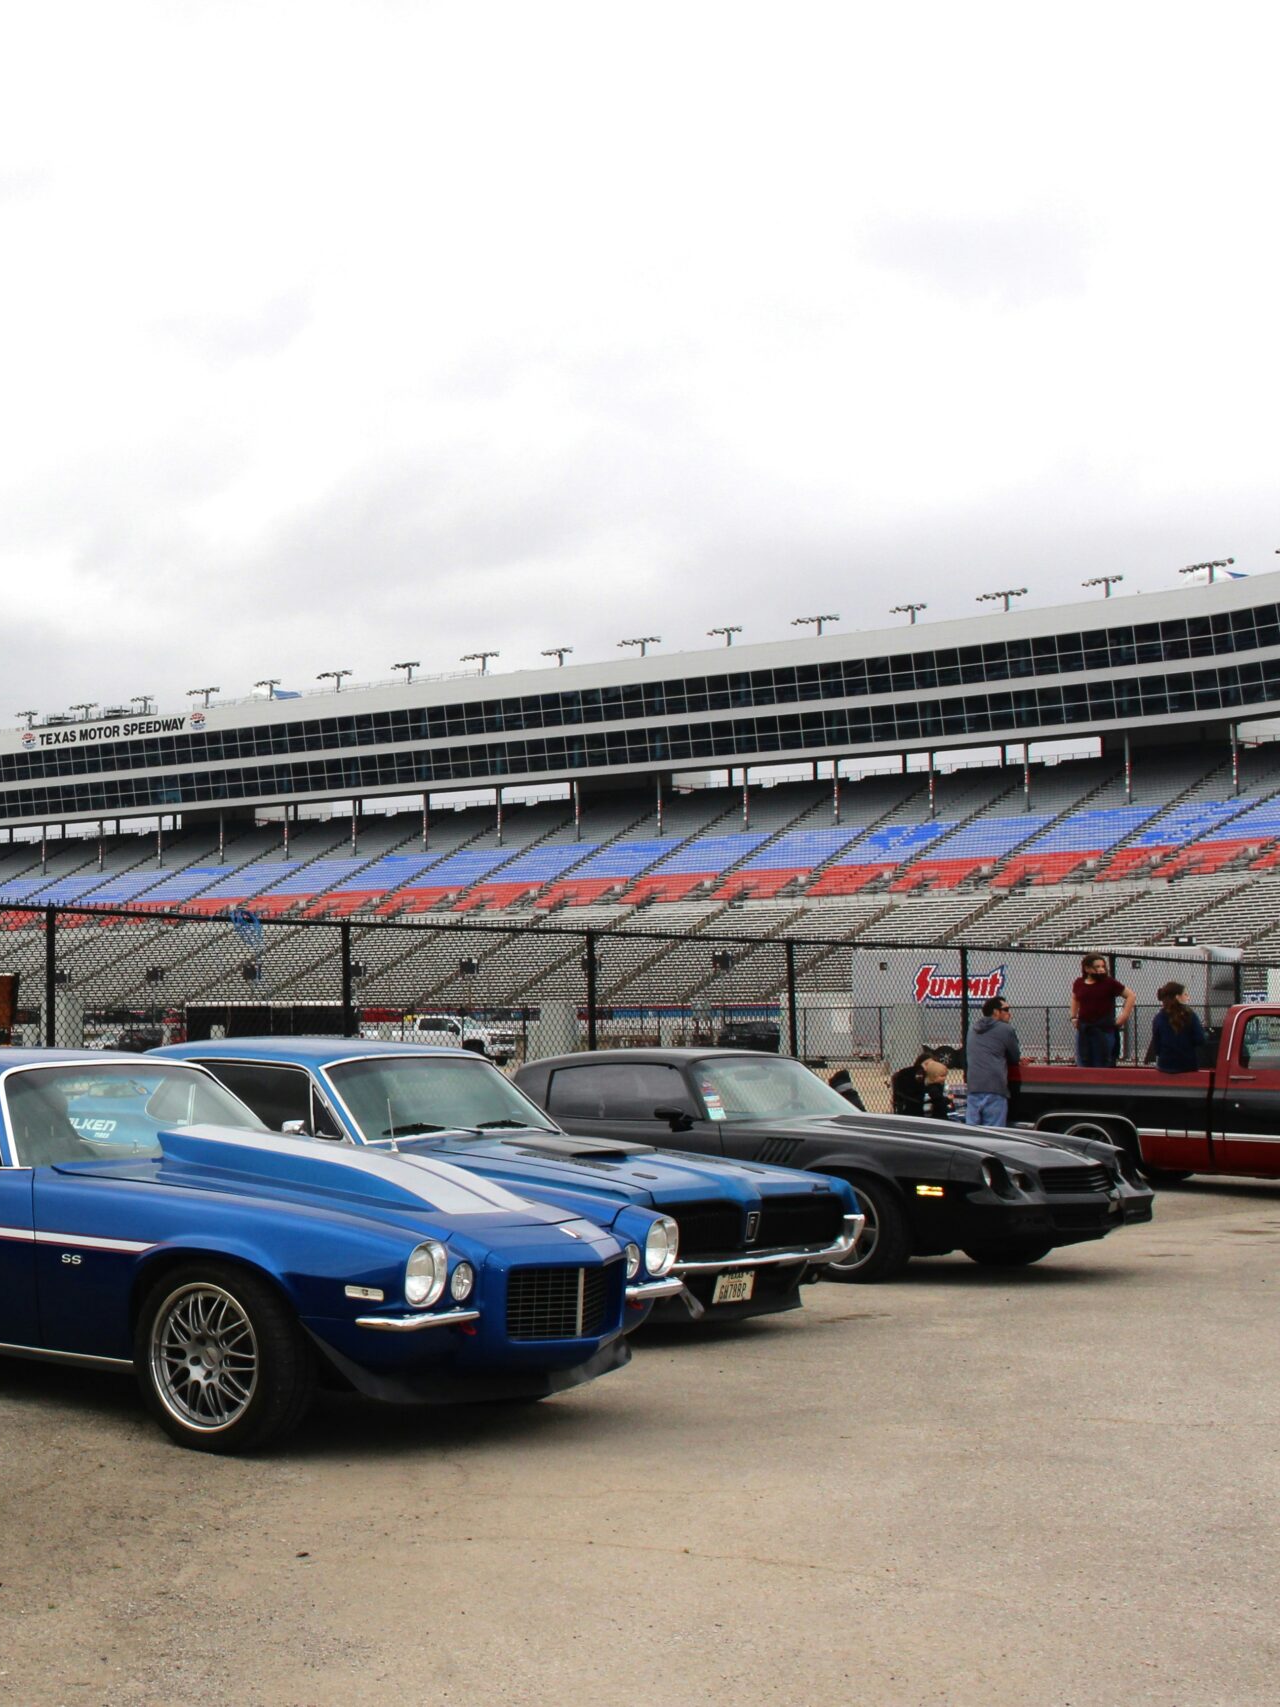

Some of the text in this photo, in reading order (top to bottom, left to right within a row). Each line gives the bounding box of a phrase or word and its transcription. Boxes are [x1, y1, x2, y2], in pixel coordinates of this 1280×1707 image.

[39, 717, 185, 745] TEXAS MOTOR SPEEDWAY
[61, 1253, 82, 1264] SS
